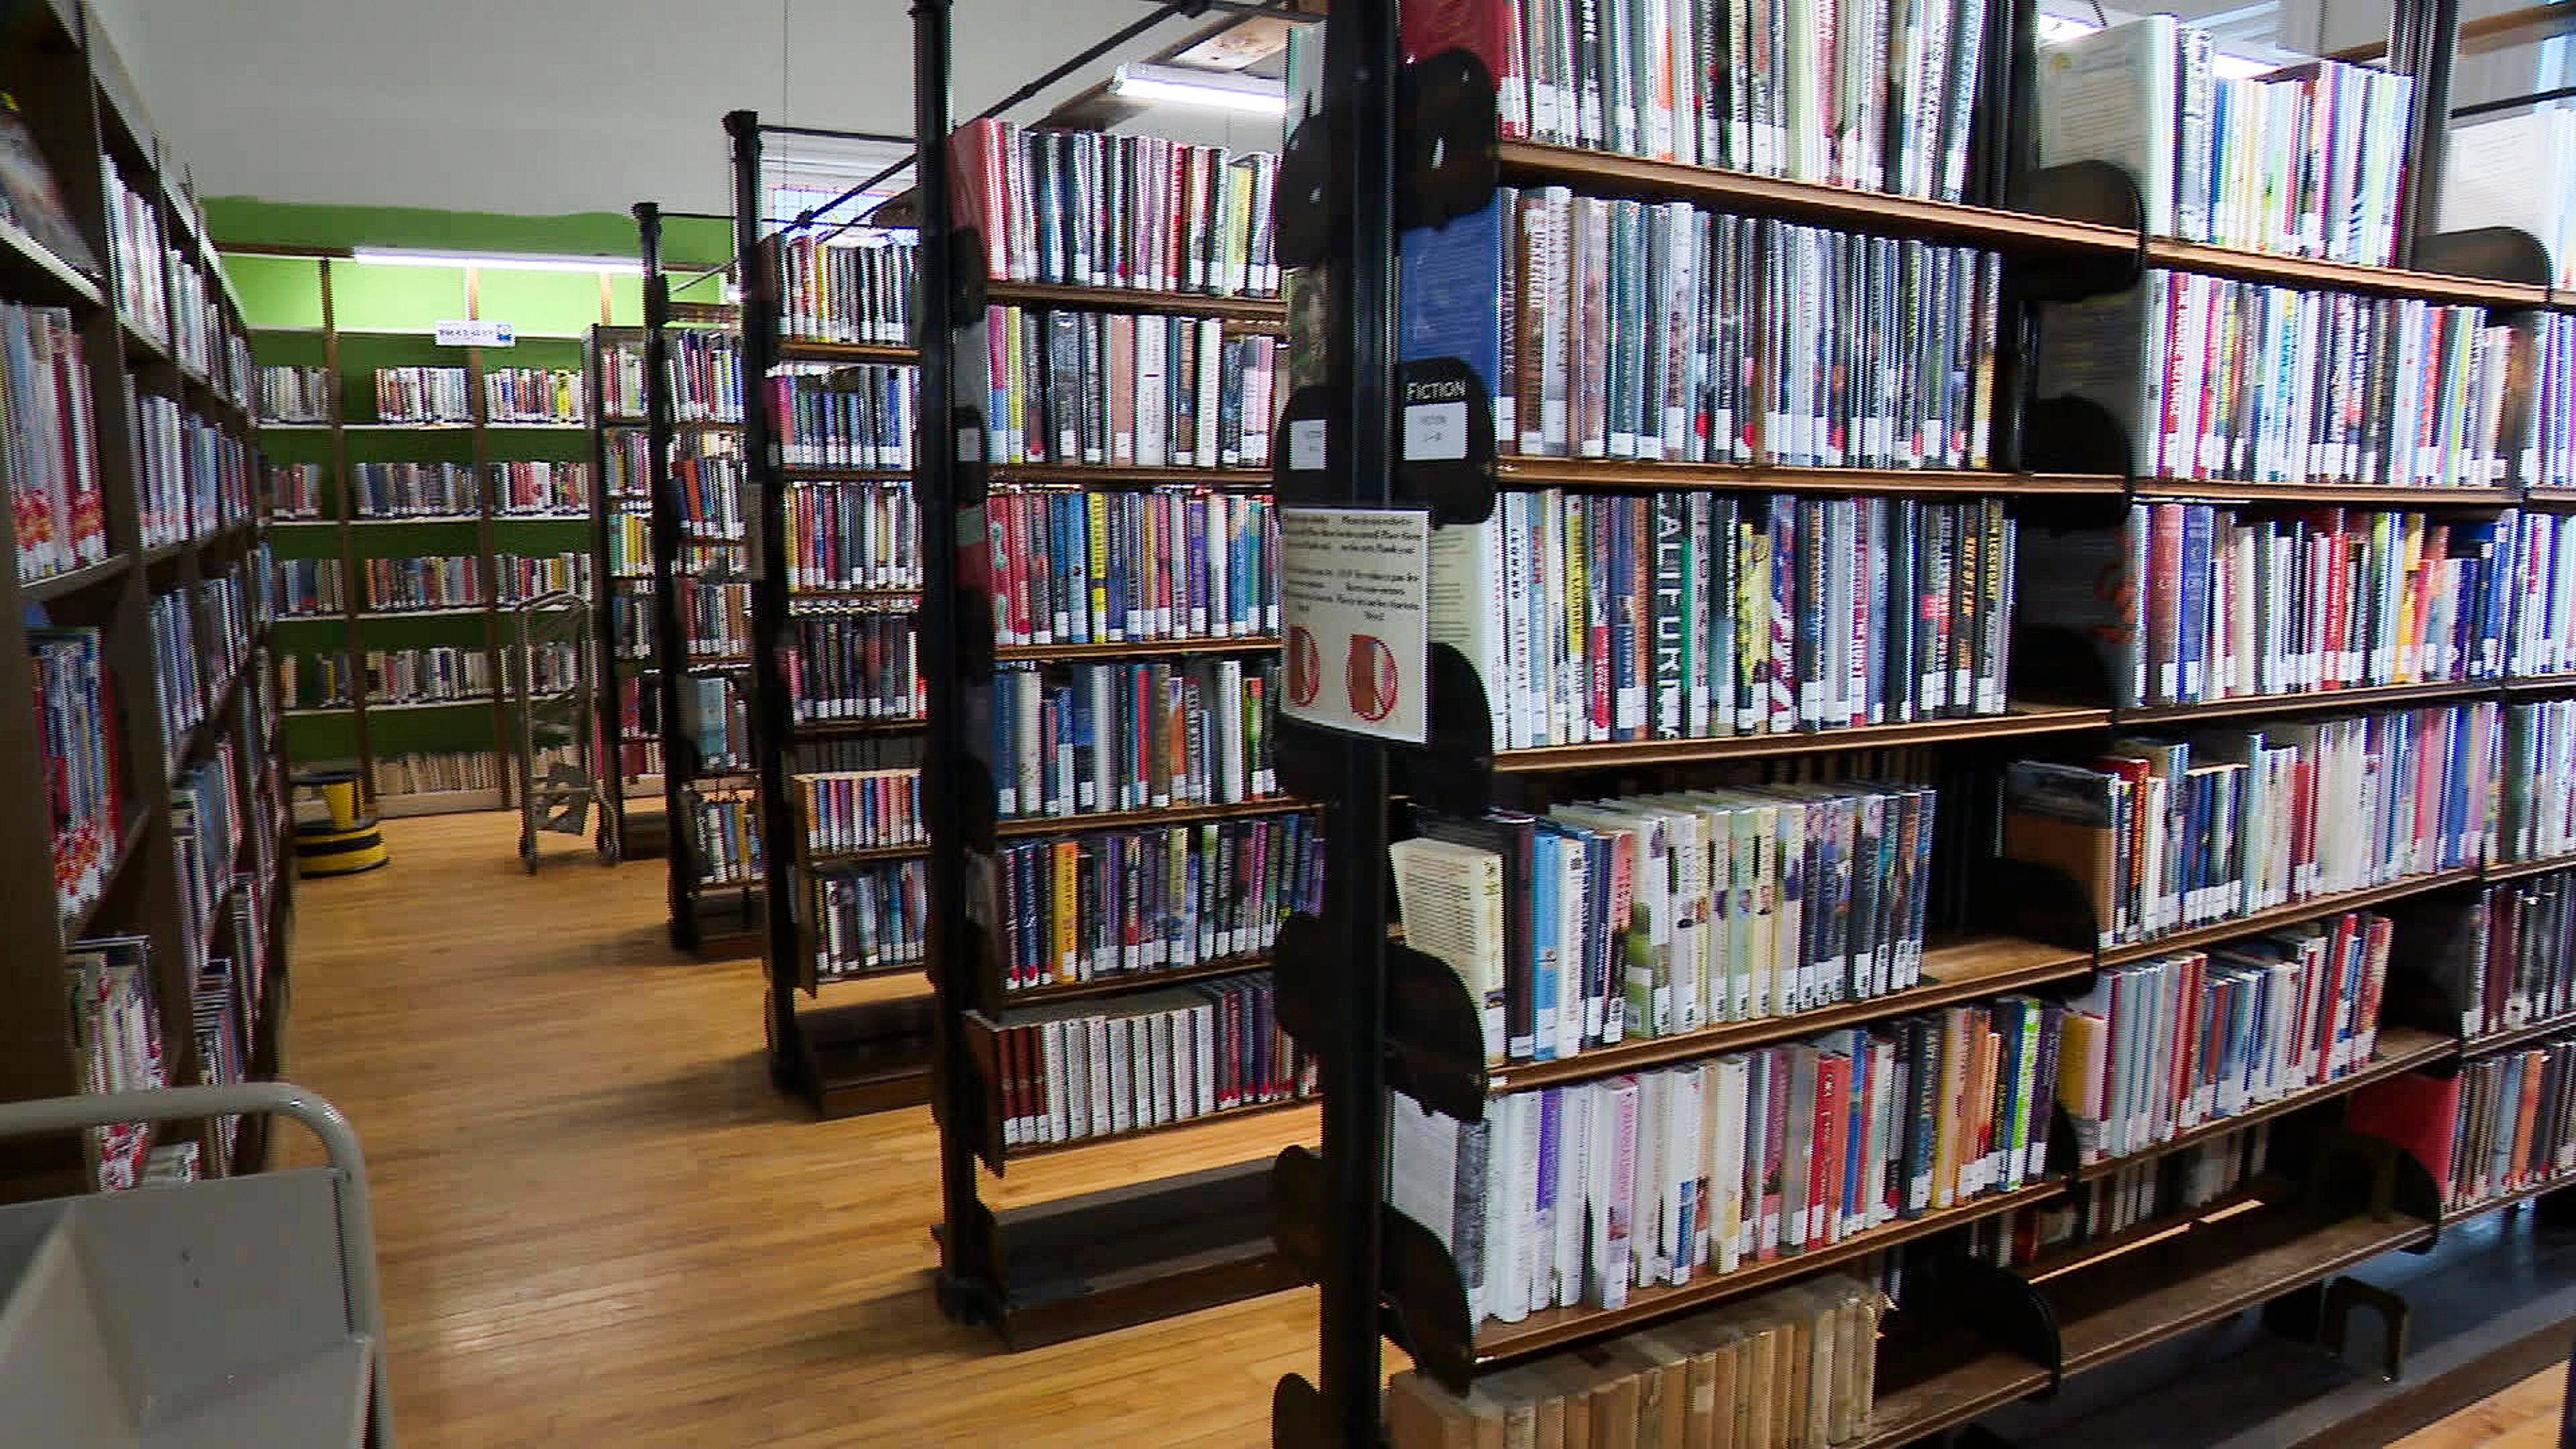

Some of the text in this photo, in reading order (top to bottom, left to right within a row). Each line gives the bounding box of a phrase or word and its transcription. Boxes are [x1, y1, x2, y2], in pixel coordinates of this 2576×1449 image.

[1407, 381, 1466, 402] FICTION
[1986, 537, 1998, 601] LESCROART
[1657, 492, 1681, 741] CALIFORA
